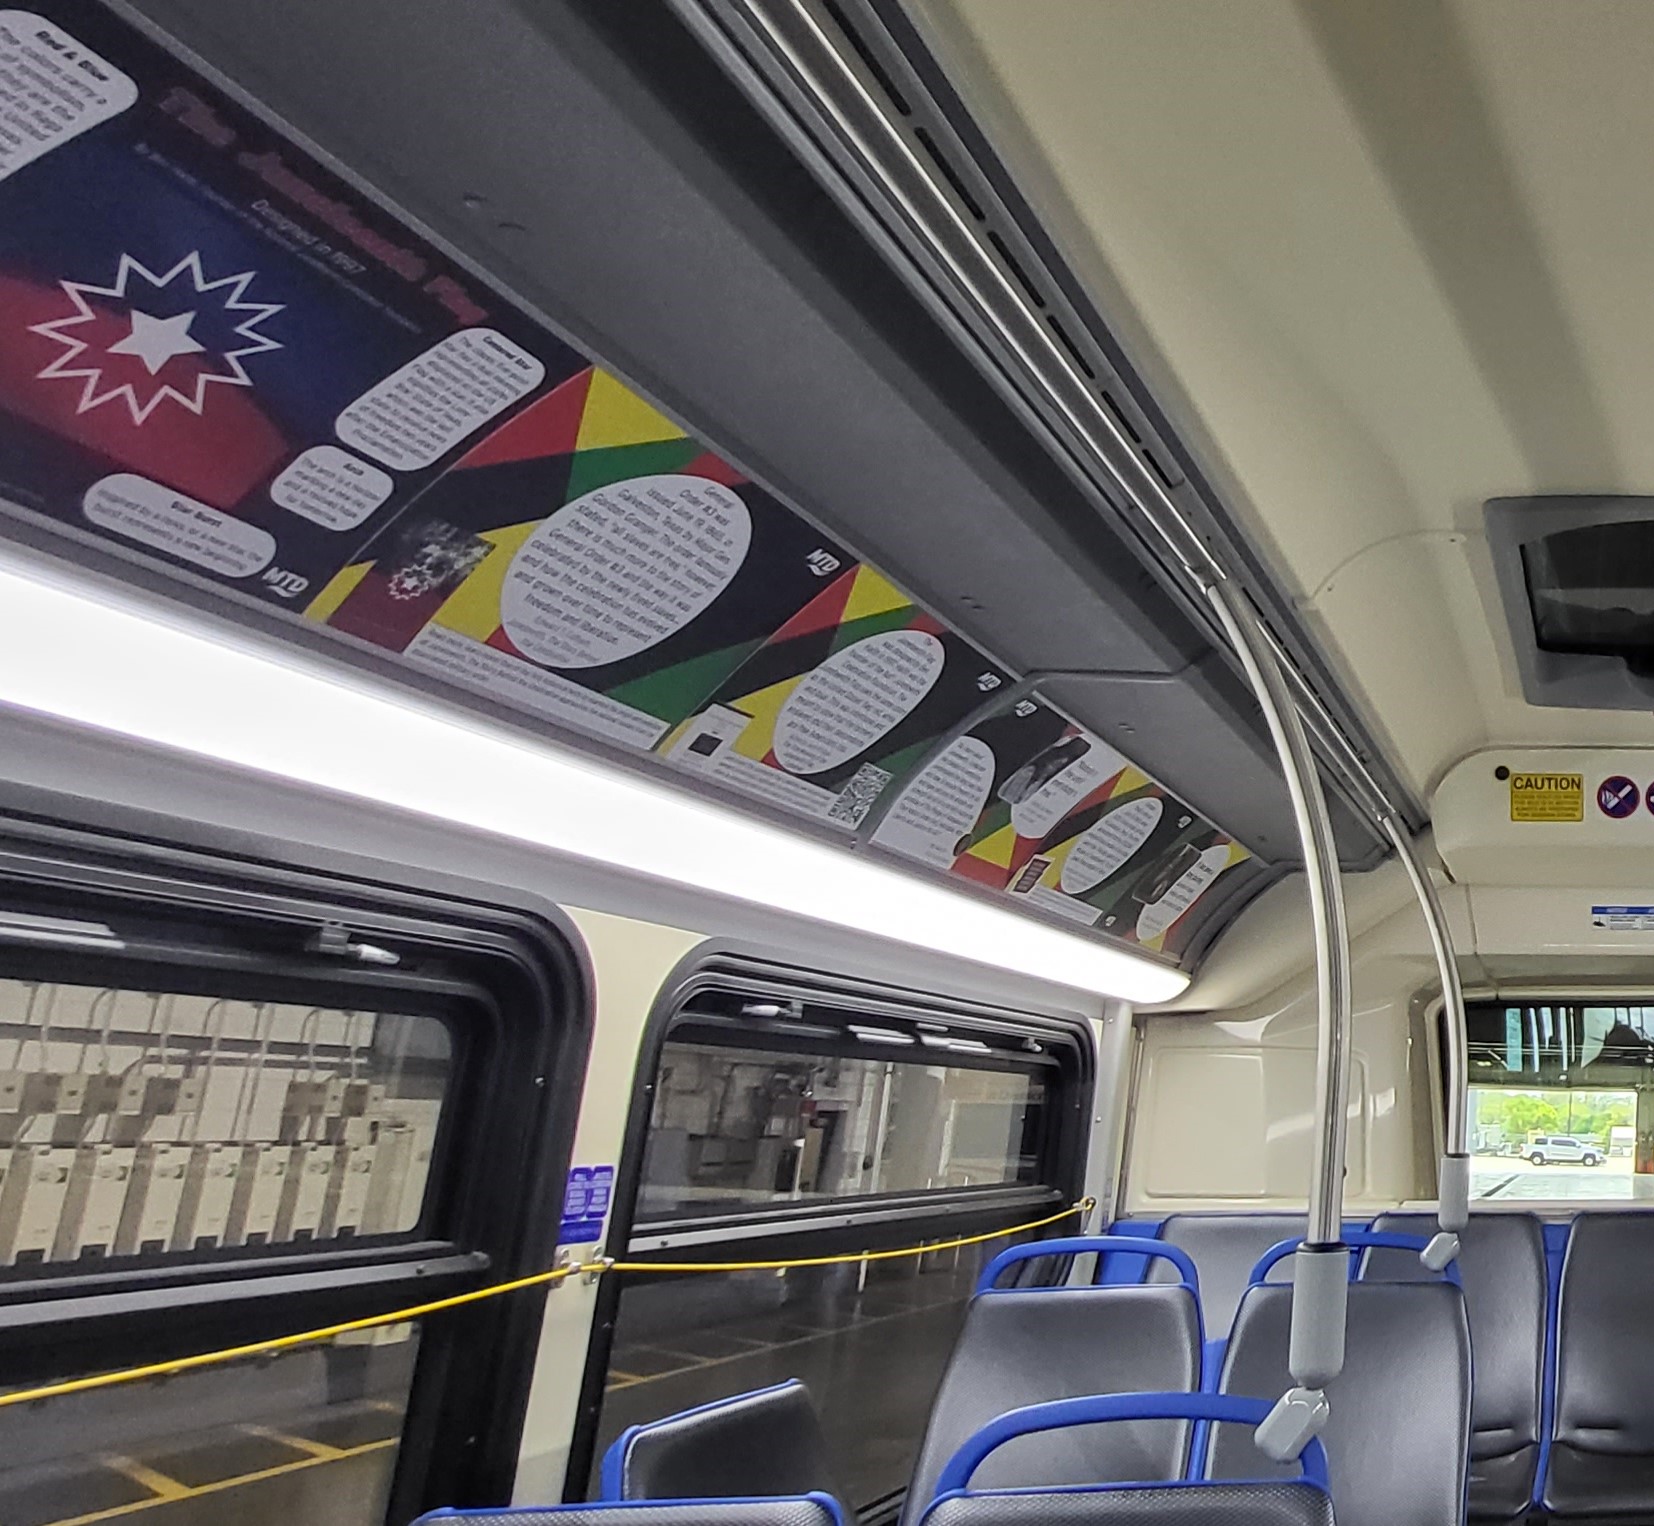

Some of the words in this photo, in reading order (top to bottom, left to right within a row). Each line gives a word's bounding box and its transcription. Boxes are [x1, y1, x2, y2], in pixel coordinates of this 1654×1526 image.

[35, 30, 67, 50] Red
[77, 60, 109, 81] Blue
[806, 548, 841, 577] MTD
[262, 566, 309, 598] MTD
[1514, 776, 1581, 790] CAUTION
